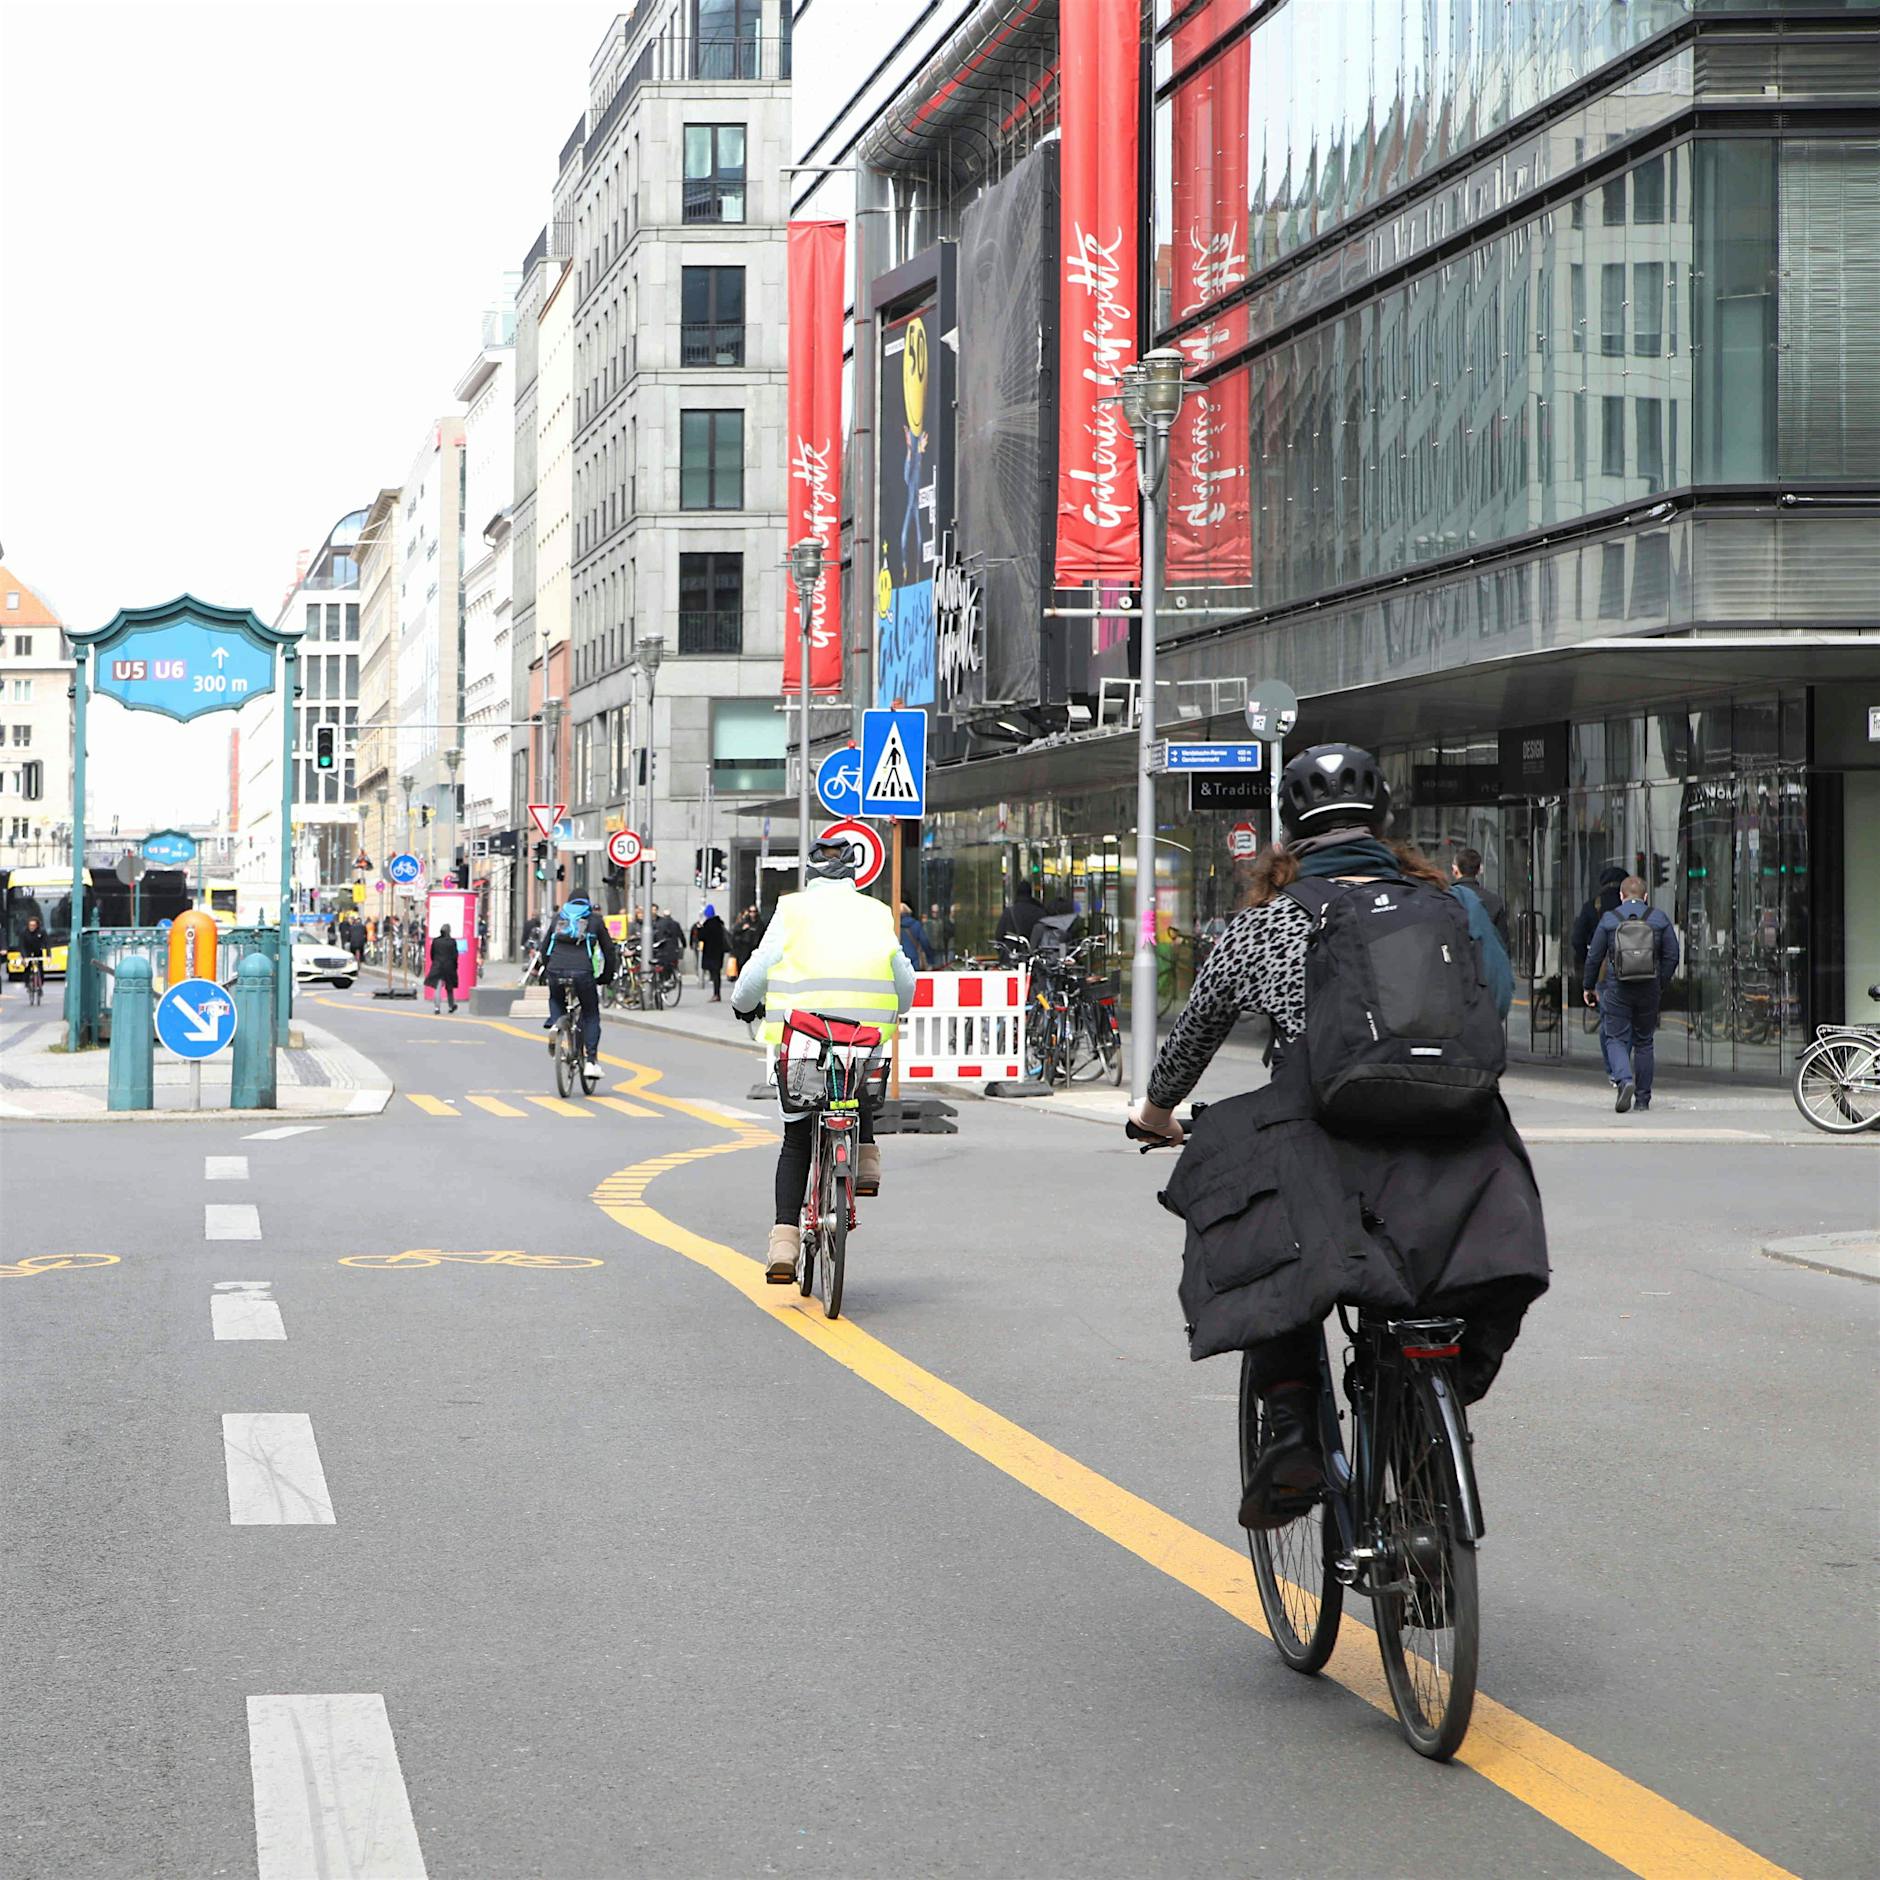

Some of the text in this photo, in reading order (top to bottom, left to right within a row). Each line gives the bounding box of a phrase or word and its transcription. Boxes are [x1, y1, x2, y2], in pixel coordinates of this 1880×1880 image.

[1066, 221, 1132, 528] Galeries Lafayette
[115, 661, 185, 679] U5 U6
[193, 676, 248, 692] 300 m
[1522, 739, 1545, 760] DESIGN
[1200, 782, 1272, 796] &Traditio
[617, 840, 636, 855] 50
